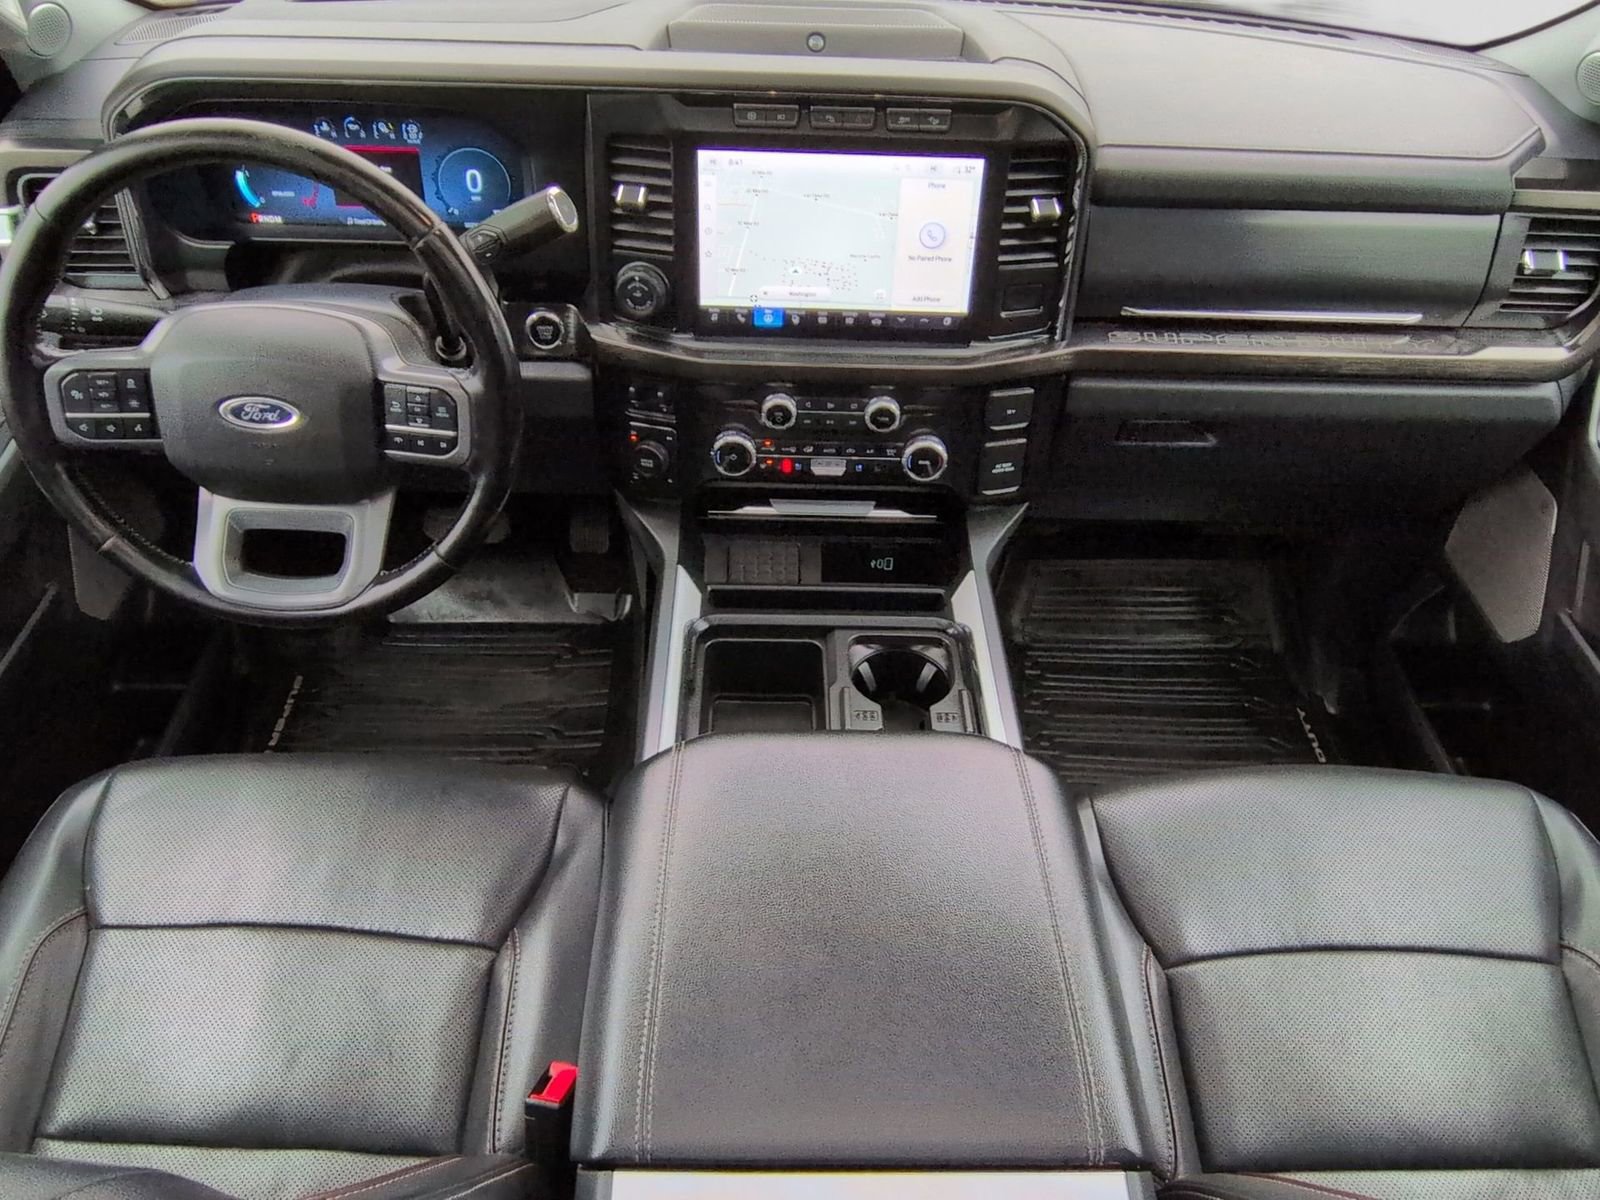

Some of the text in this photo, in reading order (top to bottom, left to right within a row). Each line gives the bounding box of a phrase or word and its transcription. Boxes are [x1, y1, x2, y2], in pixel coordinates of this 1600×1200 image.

[466, 168, 482, 193] 0
[928, 182, 946, 190] Phone
[241, 403, 281, 422] Ford
[1296, 706, 1327, 764] DUTY
